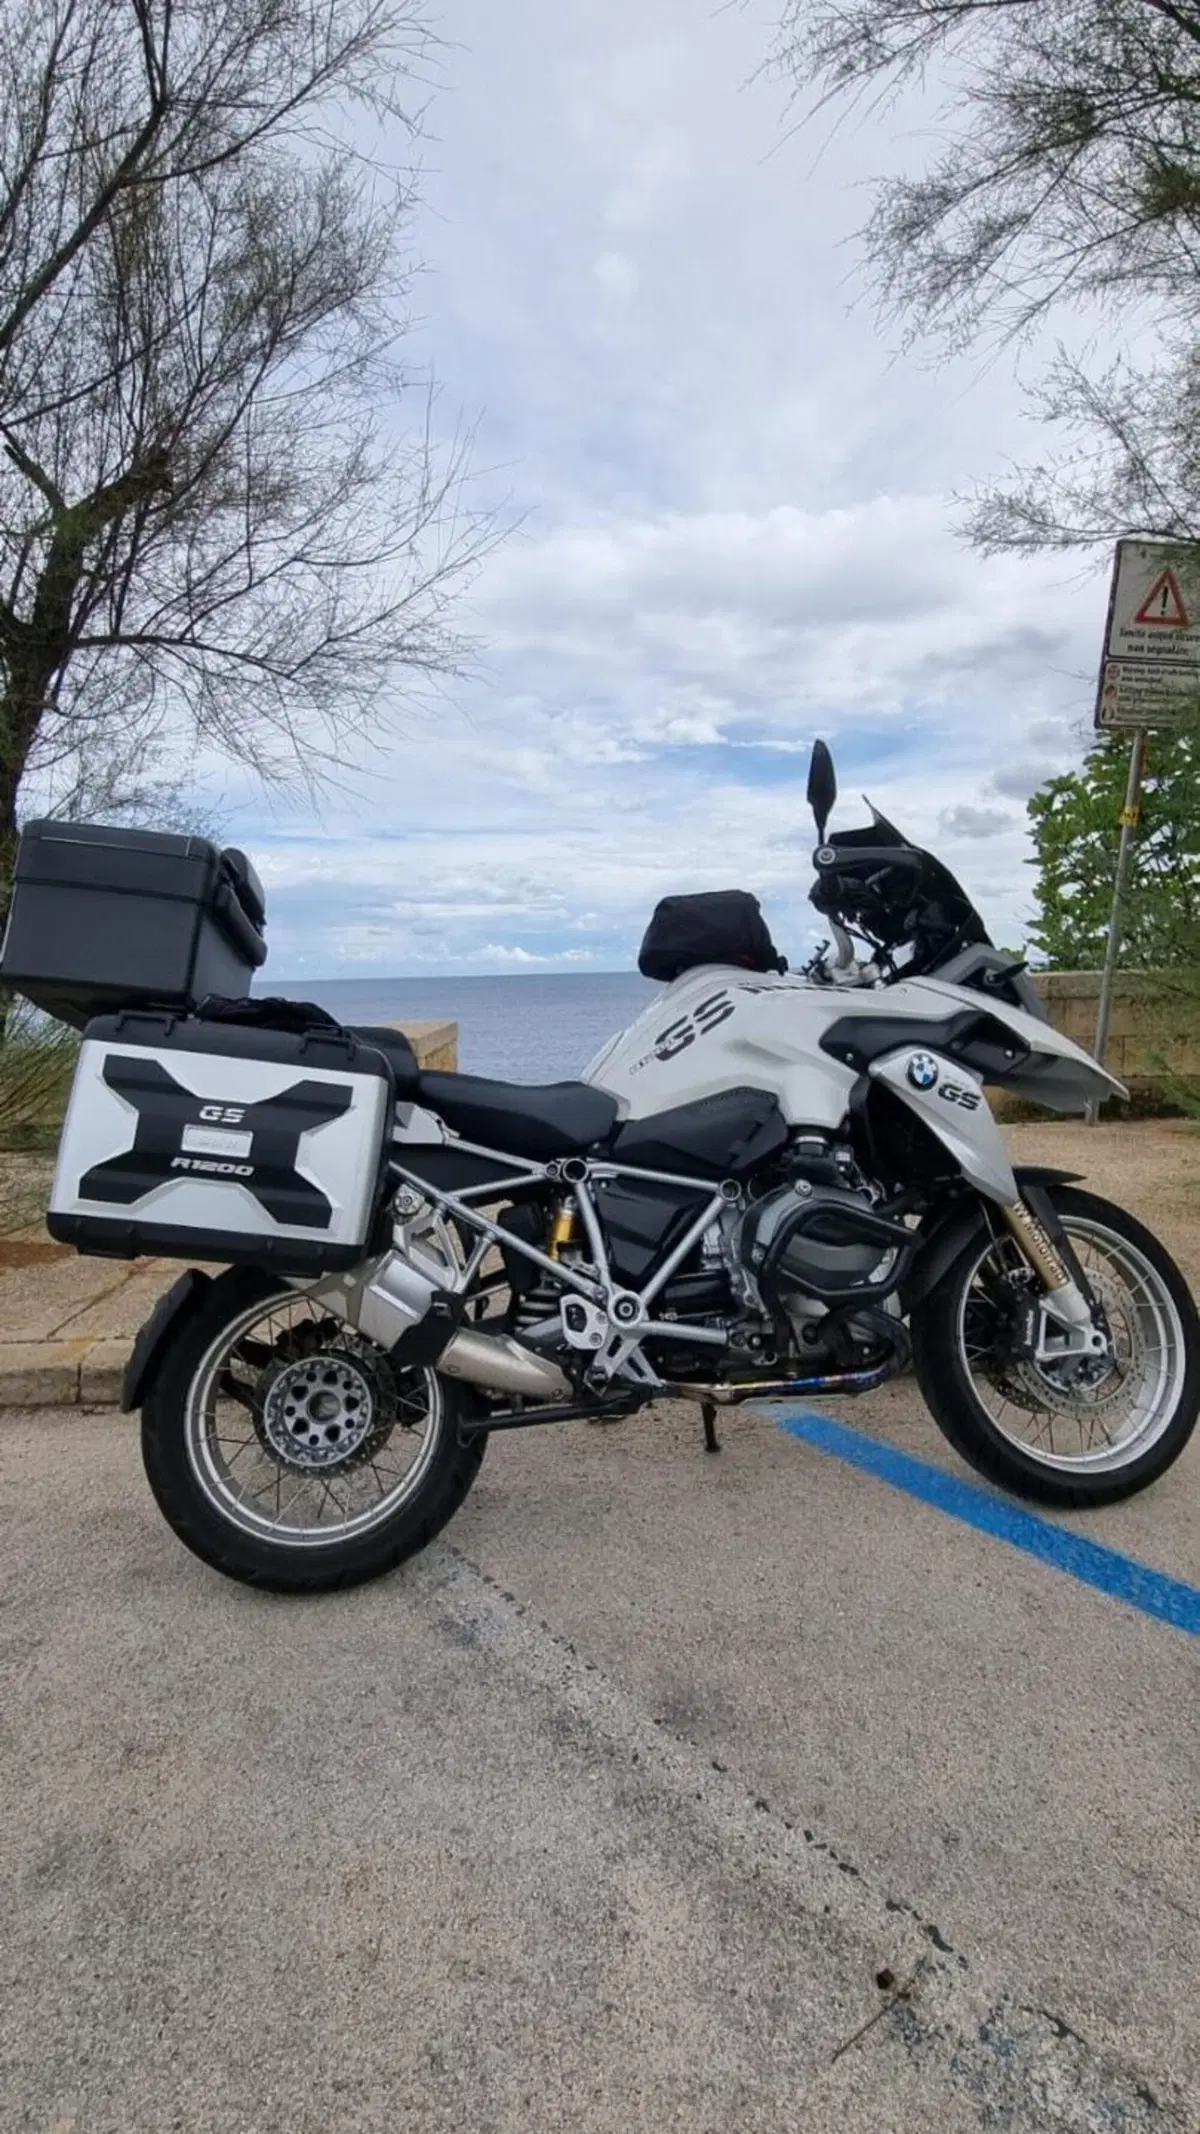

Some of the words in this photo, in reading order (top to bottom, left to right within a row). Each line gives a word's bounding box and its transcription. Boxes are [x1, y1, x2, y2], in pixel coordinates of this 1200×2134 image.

[654, 989, 736, 1062] GS
[937, 1082, 982, 1111] GS
[199, 1105, 246, 1123] GS
[170, 1157, 255, 1176] R1200
